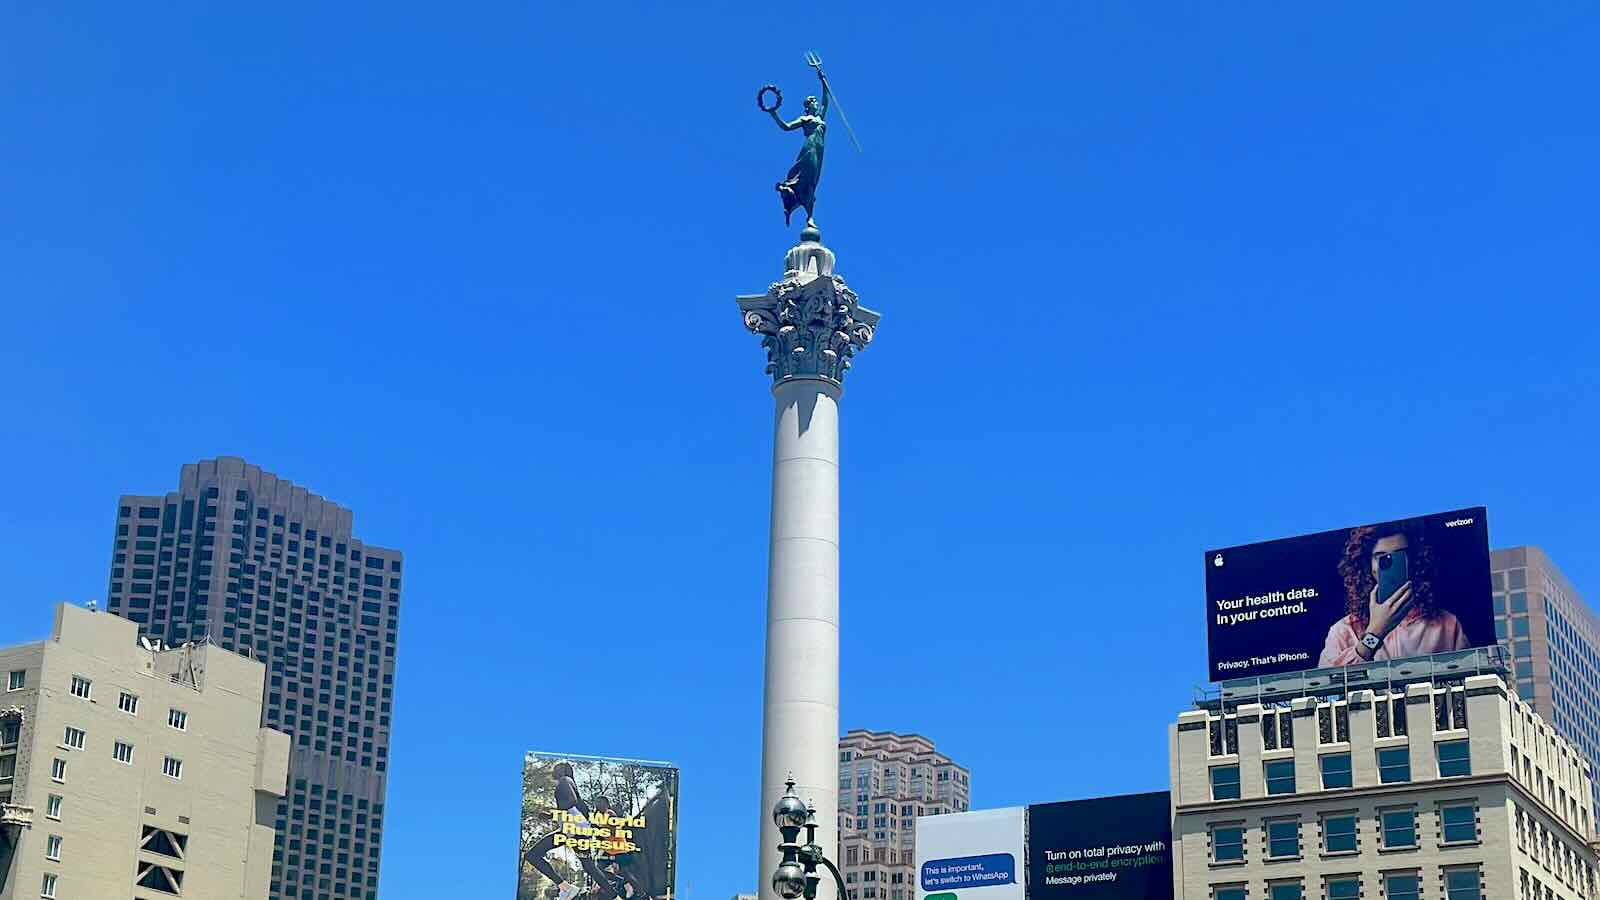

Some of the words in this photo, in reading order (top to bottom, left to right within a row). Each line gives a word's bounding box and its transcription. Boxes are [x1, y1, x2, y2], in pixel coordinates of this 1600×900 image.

[1445, 518, 1473, 527] verizon
[1216, 599, 1244, 611] Your
[1245, 591, 1284, 607] health
[1286, 588, 1319, 600] data.
[1217, 614, 1228, 624] In
[1230, 610, 1258, 625] your
[1260, 602, 1307, 618] control.
[1218, 660, 1250, 670] Privacy.
[1251, 655, 1277, 666] That's
[1278, 652, 1309, 662] iPhone.
[550, 809, 587, 822] The
[588, 811, 646, 828] World
[562, 822, 611, 837] Runs
[615, 826, 632, 838] in
[553, 834, 641, 852] Pegasus.
[1045, 850, 1066, 860] Turn
[1068, 851, 1081, 859] on
[1083, 846, 1105, 857] total
[1106, 844, 1142, 857] privacy
[1144, 841, 1165, 852] with
[948, 864, 984, 873] important,
[1055, 860, 1108, 872] end-to-end
[1110, 854, 1164, 868] encryption
[940, 876, 962, 884] switch
[972, 871, 1009, 881] WhatsApp
[1045, 876, 1082, 885] Message
[1083, 871, 1117, 883] privately
